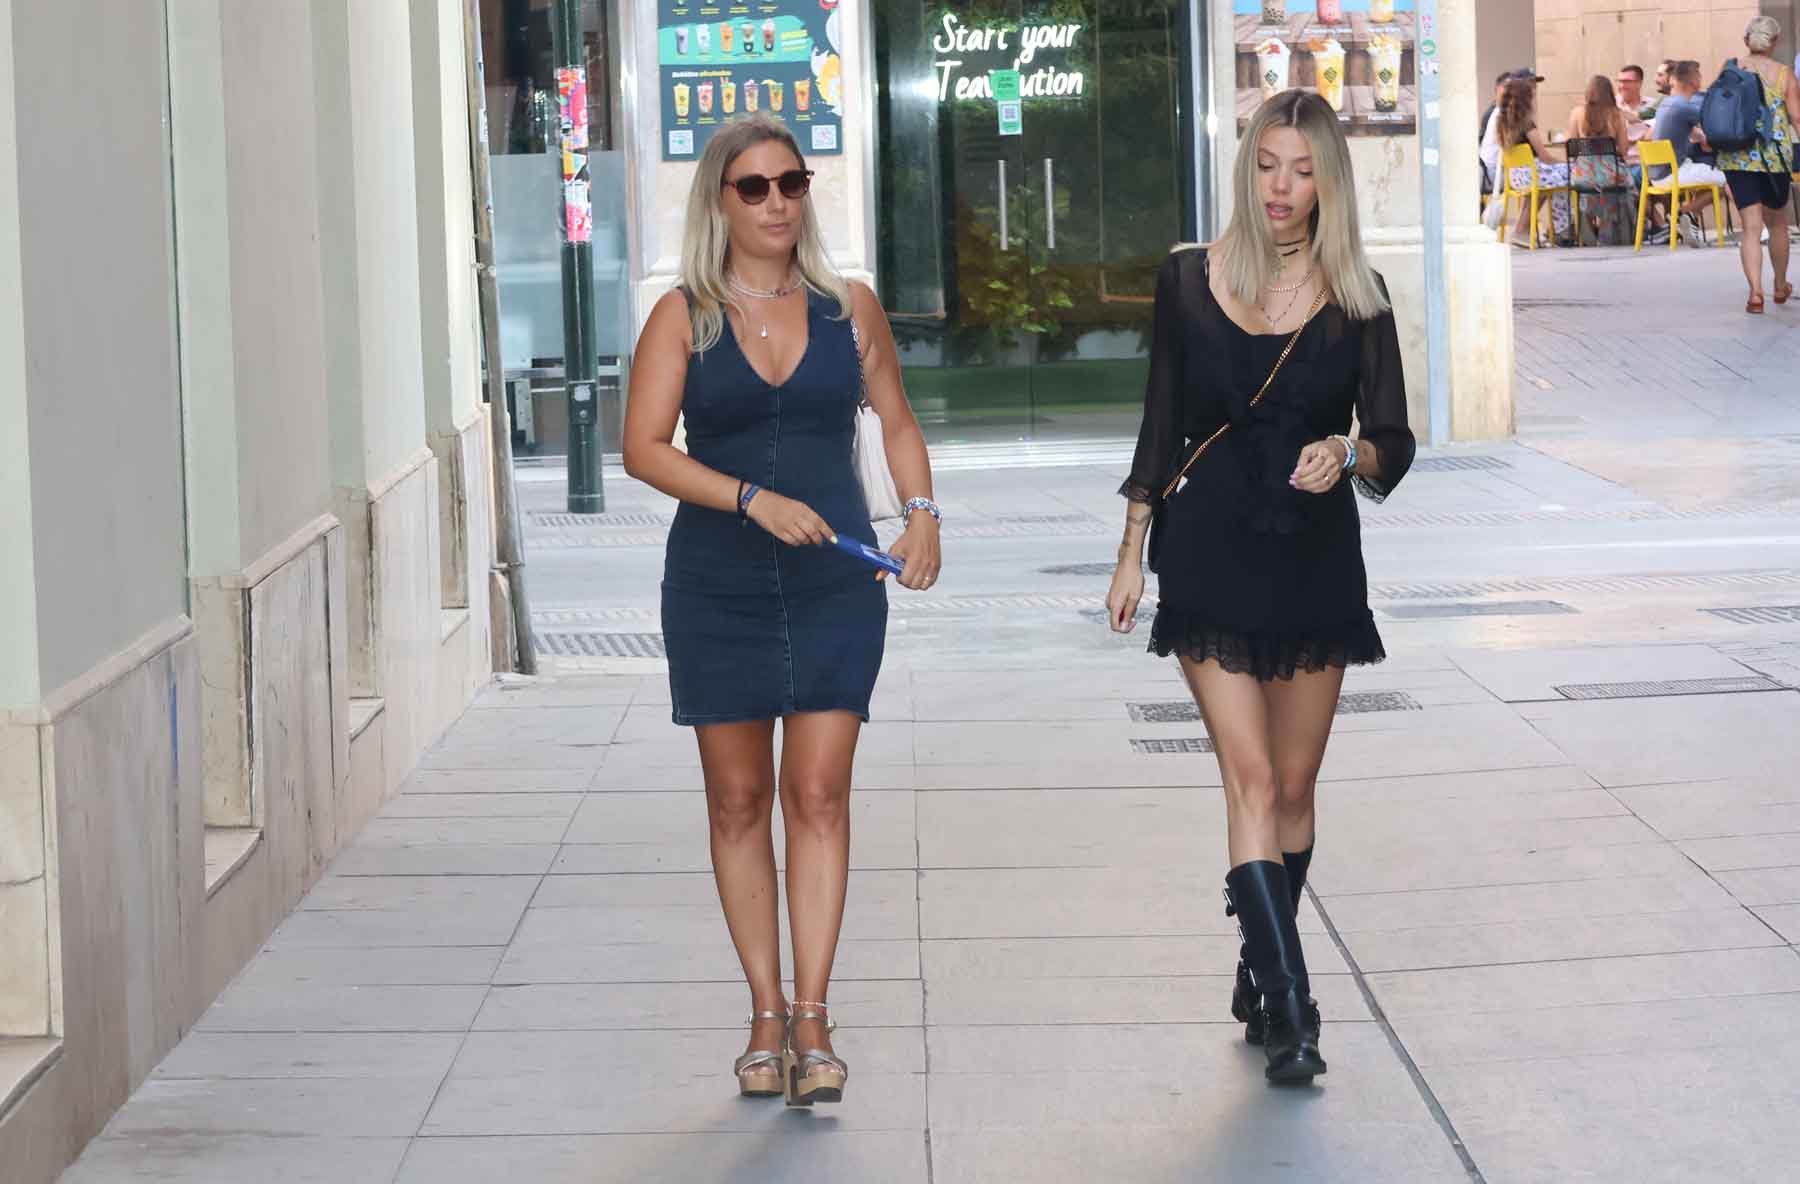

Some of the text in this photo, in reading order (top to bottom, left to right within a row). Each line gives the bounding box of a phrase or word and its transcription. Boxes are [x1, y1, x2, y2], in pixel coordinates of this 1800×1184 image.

[933, 13, 1081, 63] Start your
[935, 58, 1083, 101] Teavution
